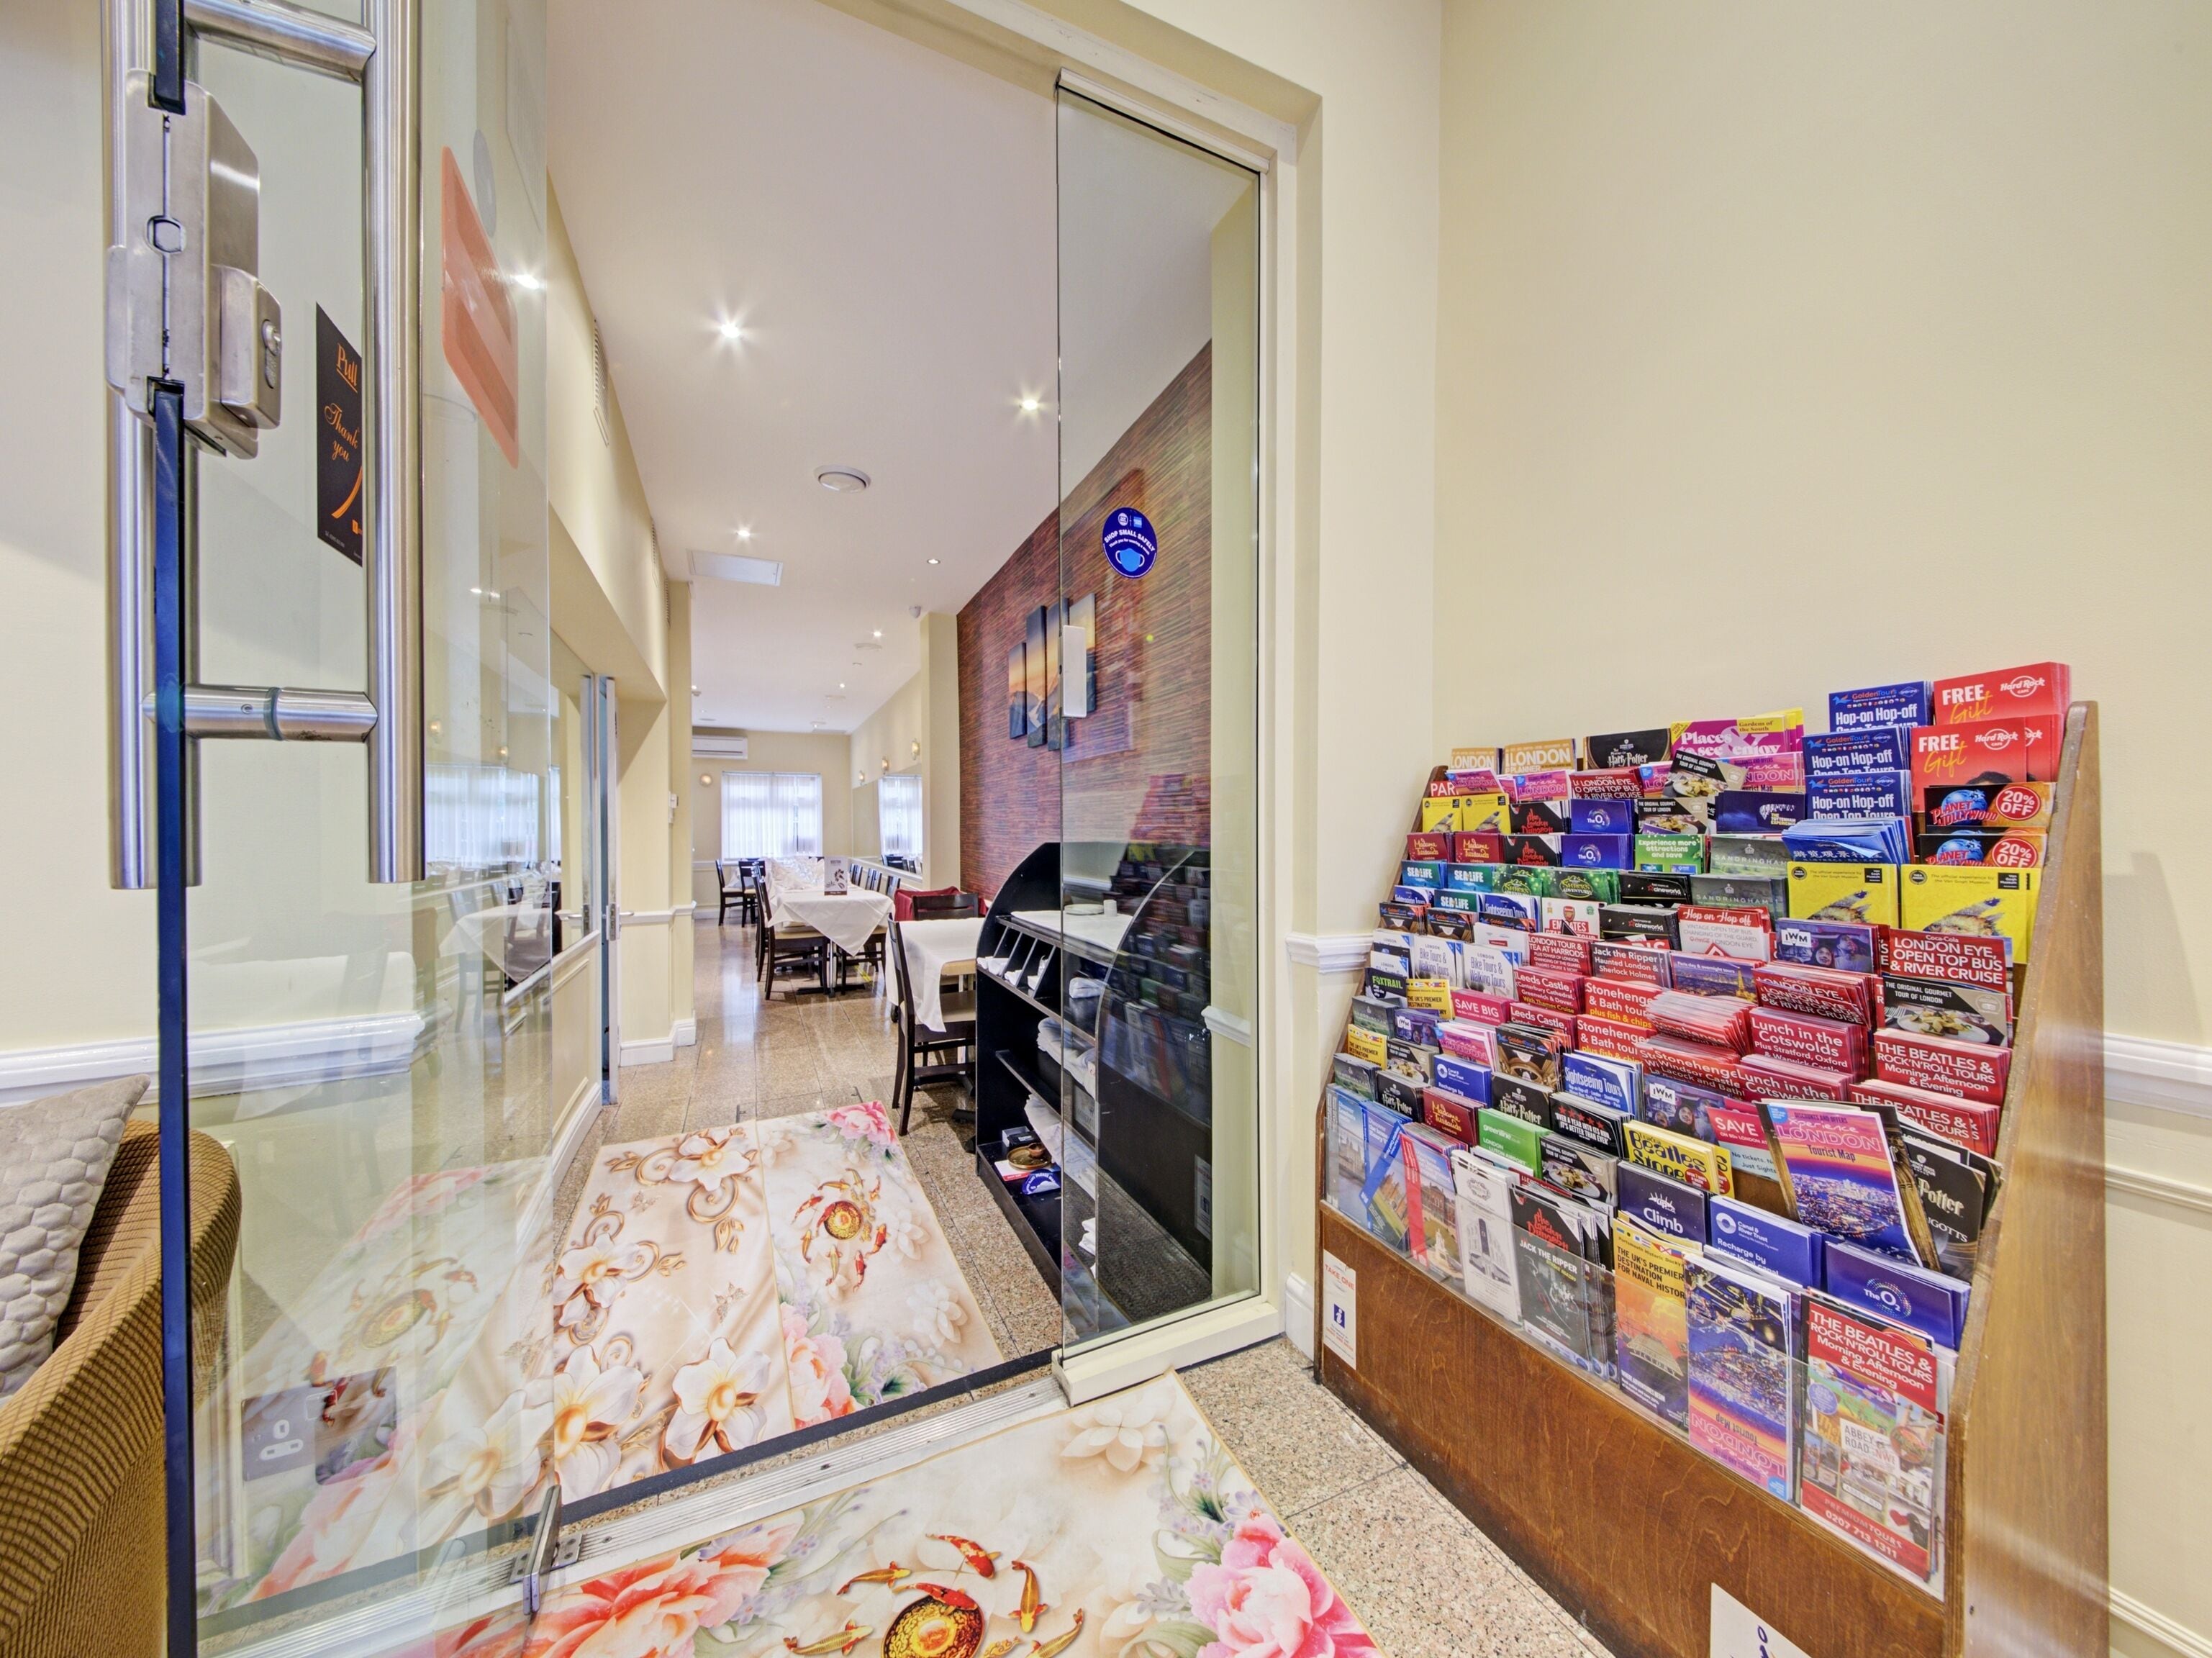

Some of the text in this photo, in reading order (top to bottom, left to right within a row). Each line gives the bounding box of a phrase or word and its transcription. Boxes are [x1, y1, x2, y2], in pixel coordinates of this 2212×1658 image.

[336, 343, 357, 386] Pull
[324, 402, 358, 449] Thank
[332, 440, 350, 462] you
[1104, 530, 1118, 543] SHOP
[1118, 529, 1137, 538] SMALL
[1138, 533, 1156, 552] SAFELY
[1943, 677, 2044, 706] FREE Hard Rock
[1836, 704, 1918, 725] Hop-on Hop-off
[1681, 732, 1732, 745] Places
[1919, 732, 2018, 752] FREE Hard Rock
[1812, 749, 1893, 770] Hop-on Hop-off
[1923, 740, 1967, 778] Gift
[1813, 794, 1894, 812] Hop-on Hop-off
[2000, 803, 2034, 815] OFF
[2003, 791, 2035, 805] 20%
[1931, 800, 1974, 825] PLANET
[2000, 844, 2032, 858] 20%
[1697, 894, 1769, 904] SANDRINGHAM
[1683, 909, 1702, 922] Hop
[1716, 910, 1736, 924] Hop
[1737, 914, 1751, 925] off
[1529, 937, 1557, 946] LONDON
[1785, 931, 1808, 943] IWM
[1593, 948, 1657, 962] Jack the Ripper
[1893, 950, 2003, 971] OPEN TOP BUS
[1895, 938, 1997, 961] LONDON EYE,
[1471, 959, 1483, 970] Bike
[1483, 961, 1497, 973] Tours
[1595, 957, 1623, 966] Haunted
[1624, 961, 1651, 970] London
[1599, 966, 1656, 979] Sherlock Holmes
[1890, 958, 2003, 985] & RIVER CRUISE
[1517, 972, 1572, 993] Leeds Castle,
[1896, 983, 1923, 994] ORIGINAL
[1925, 987, 1952, 998] GOURMET
[1586, 983, 1652, 1007] Stonehenge
[1895, 990, 1910, 999] TOUR
[1919, 995, 1944, 1005] LONDON
[1455, 999, 1499, 1017] SAVE BIG
[1511, 1007, 1567, 1030] Leeds Castle,
[1590, 1009, 1605, 1018] plus
[1608, 1010, 1620, 1020] fish
[1631, 1015, 1651, 1028] chips
[1780, 1000, 1864, 1024] RIVER CRUISE
[1751, 1018, 1843, 1047] Lunch in the
[1759, 1030, 1839, 1057] Cotswolds
[1755, 1041, 1848, 1067] Plus Stratford, Oxford
[1876, 1041, 1993, 1074] THE BEATLES &
[1656, 1059, 1740, 1088] Windsor Castle
[1877, 1053, 1995, 1084] ROCK'N'ROLL TOURS
[1885, 1063, 1989, 1092] Morning, Afternoon
[1565, 1066, 1603, 1092] Sightseeing
[1603, 1078, 1623, 1097] Tours
[1653, 1087, 1672, 1099] IWM
[1737, 1069, 1829, 1100] Lunch in the
[1921, 1080, 1964, 1097] Evening
[1715, 1117, 1759, 1136] SAVE
[1777, 1125, 1882, 1151] LONDON
[1489, 1146, 1505, 1156] LUTON
[1629, 1130, 1706, 1172] Beatles
[1807, 1144, 1856, 1162] Tourist Map
[1918, 1178, 1964, 1216] Potter
[1644, 1207, 1683, 1234] Climb
[1738, 1221, 1751, 1231] Canal
[1738, 1226, 1767, 1243] River Trust
[1520, 1240, 1536, 1254] JACK
[1538, 1248, 1551, 1260] THE
[1552, 1256, 1577, 1274] RIPPER
[1618, 1246, 1684, 1279] THE UK'S PREMIER
[1718, 1238, 1766, 1264] Recharge by
[1325, 1264, 1354, 1290] TAKE ONE
[1618, 1255, 1662, 1282] DESTINATION
[1618, 1264, 1685, 1299] FOR NAVAL HISTOR
[1863, 1289, 1880, 1301] The
[1810, 1321, 1933, 1384] ROCK'N'ROLL TOURS
[1811, 1310, 1931, 1372] THE BEATLES &
[1817, 1334, 1924, 1390] Morning, Afternoon
[1841, 1356, 1897, 1390] & Evening
[1845, 1425, 1873, 1441] ABBEY
[1692, 1415, 1785, 1477] LONDON
[1846, 1438, 1869, 1453] ROAD
[1826, 1510, 1897, 1559] 0207 713 1311
